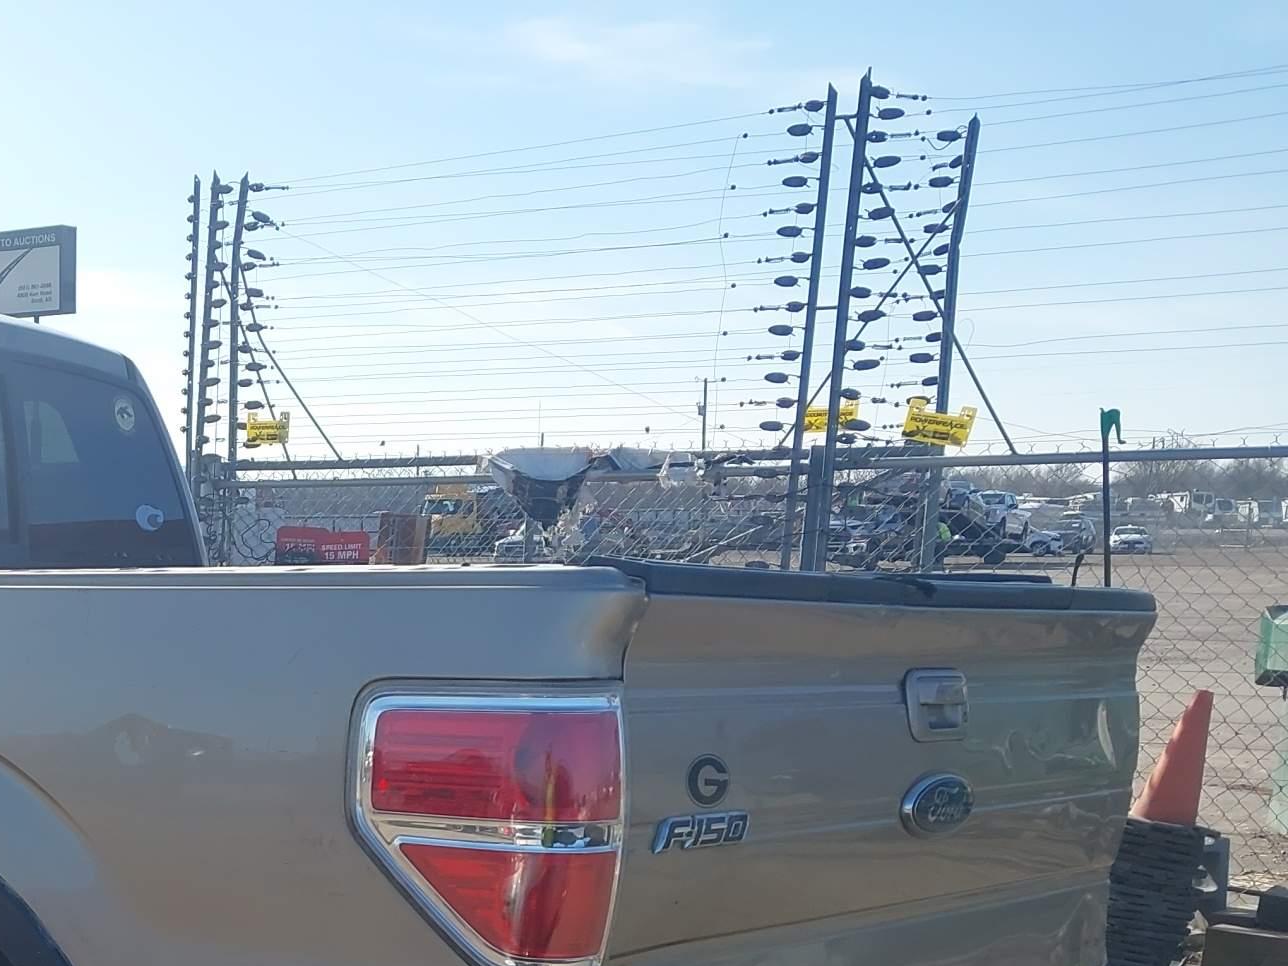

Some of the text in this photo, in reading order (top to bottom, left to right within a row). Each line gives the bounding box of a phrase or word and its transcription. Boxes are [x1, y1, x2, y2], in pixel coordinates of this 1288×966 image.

[13, 233, 56, 245] AUCTIONS
[324, 551, 359, 560] 15 MPH
[687, 755, 730, 807] G
[927, 786, 962, 822] Ford
